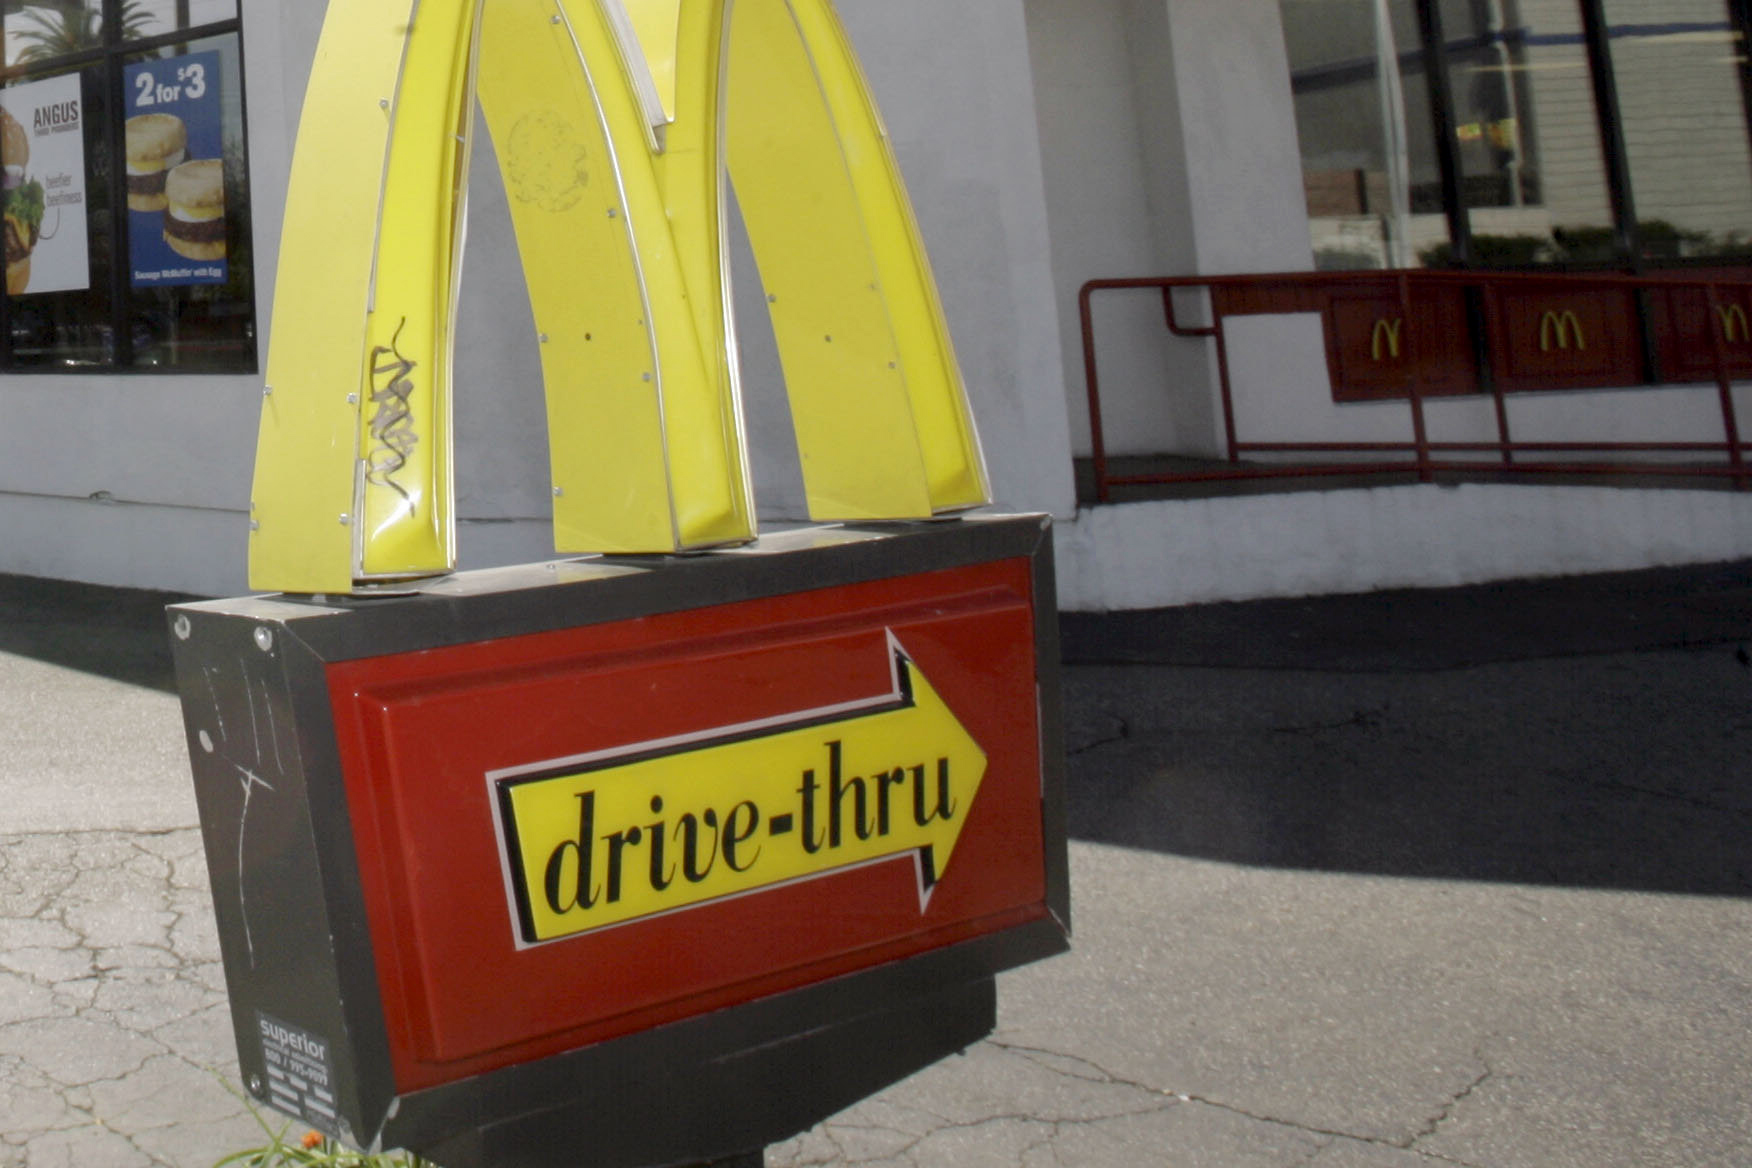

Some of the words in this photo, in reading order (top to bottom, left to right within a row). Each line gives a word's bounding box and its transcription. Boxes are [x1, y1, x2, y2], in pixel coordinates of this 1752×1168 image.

[135, 71, 155, 107] 2
[156, 83, 181, 104] for
[33, 100, 79, 129] ANGUS
[544, 738, 958, 915] drive-thru
[260, 1019, 326, 1061] superior
